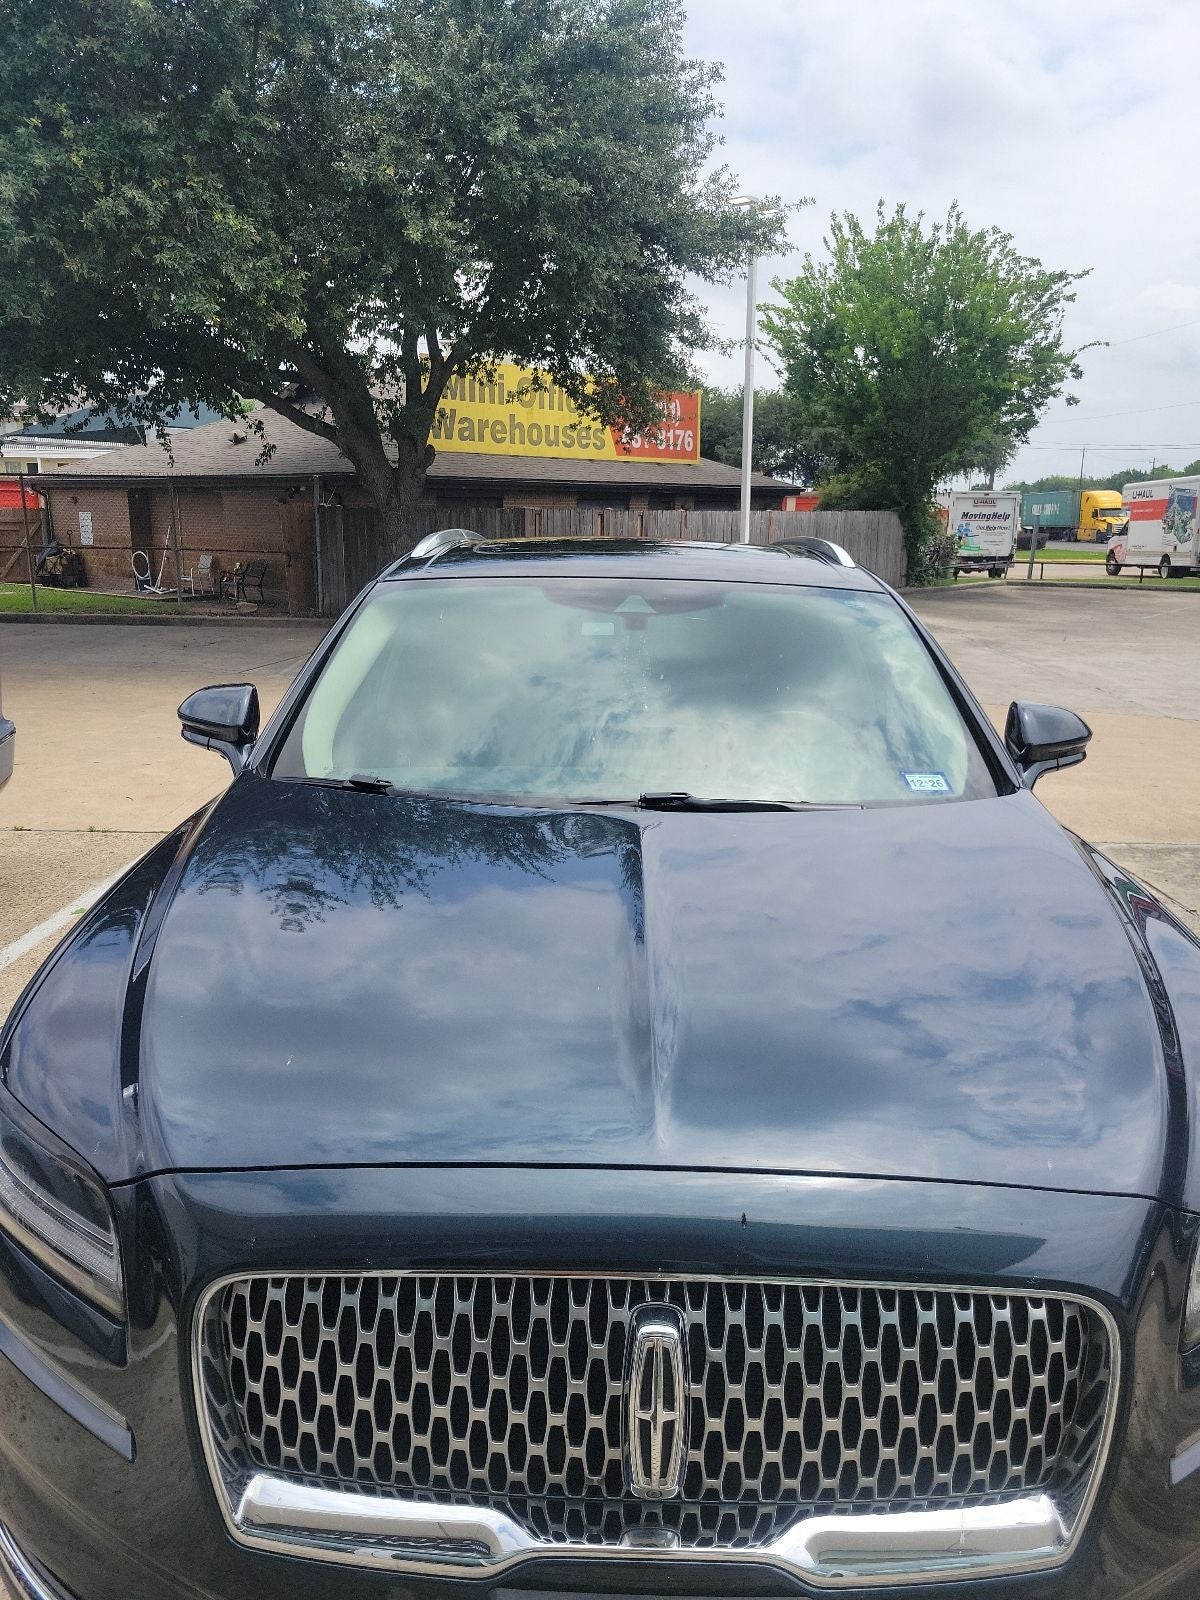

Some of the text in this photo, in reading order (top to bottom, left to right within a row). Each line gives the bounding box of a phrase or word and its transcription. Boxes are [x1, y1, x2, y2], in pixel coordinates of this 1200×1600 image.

[431, 408, 606, 451] Warehouses
[1132, 489, 1154, 499] U-HAUL
[961, 511, 1011, 522] MovingHelp
